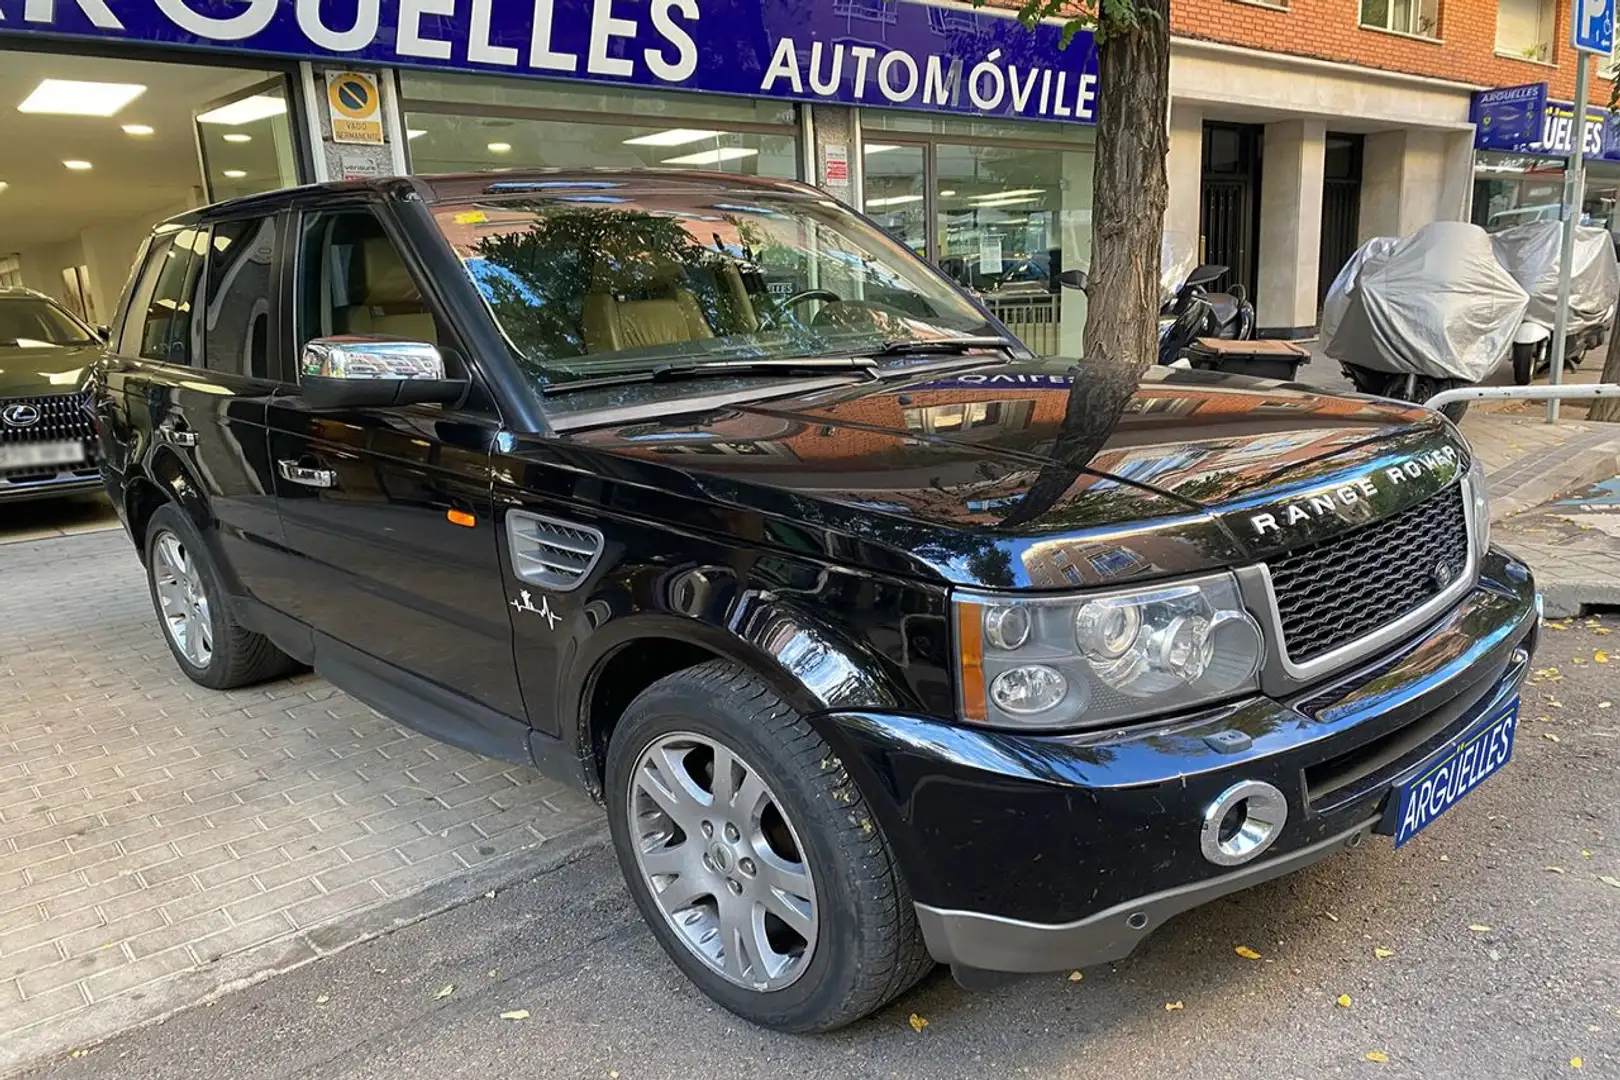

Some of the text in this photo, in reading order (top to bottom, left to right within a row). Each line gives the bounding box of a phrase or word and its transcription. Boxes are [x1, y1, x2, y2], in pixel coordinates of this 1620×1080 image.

[345, 122, 367, 131] VADO
[1251, 445, 1457, 535] RANGE ROVER
